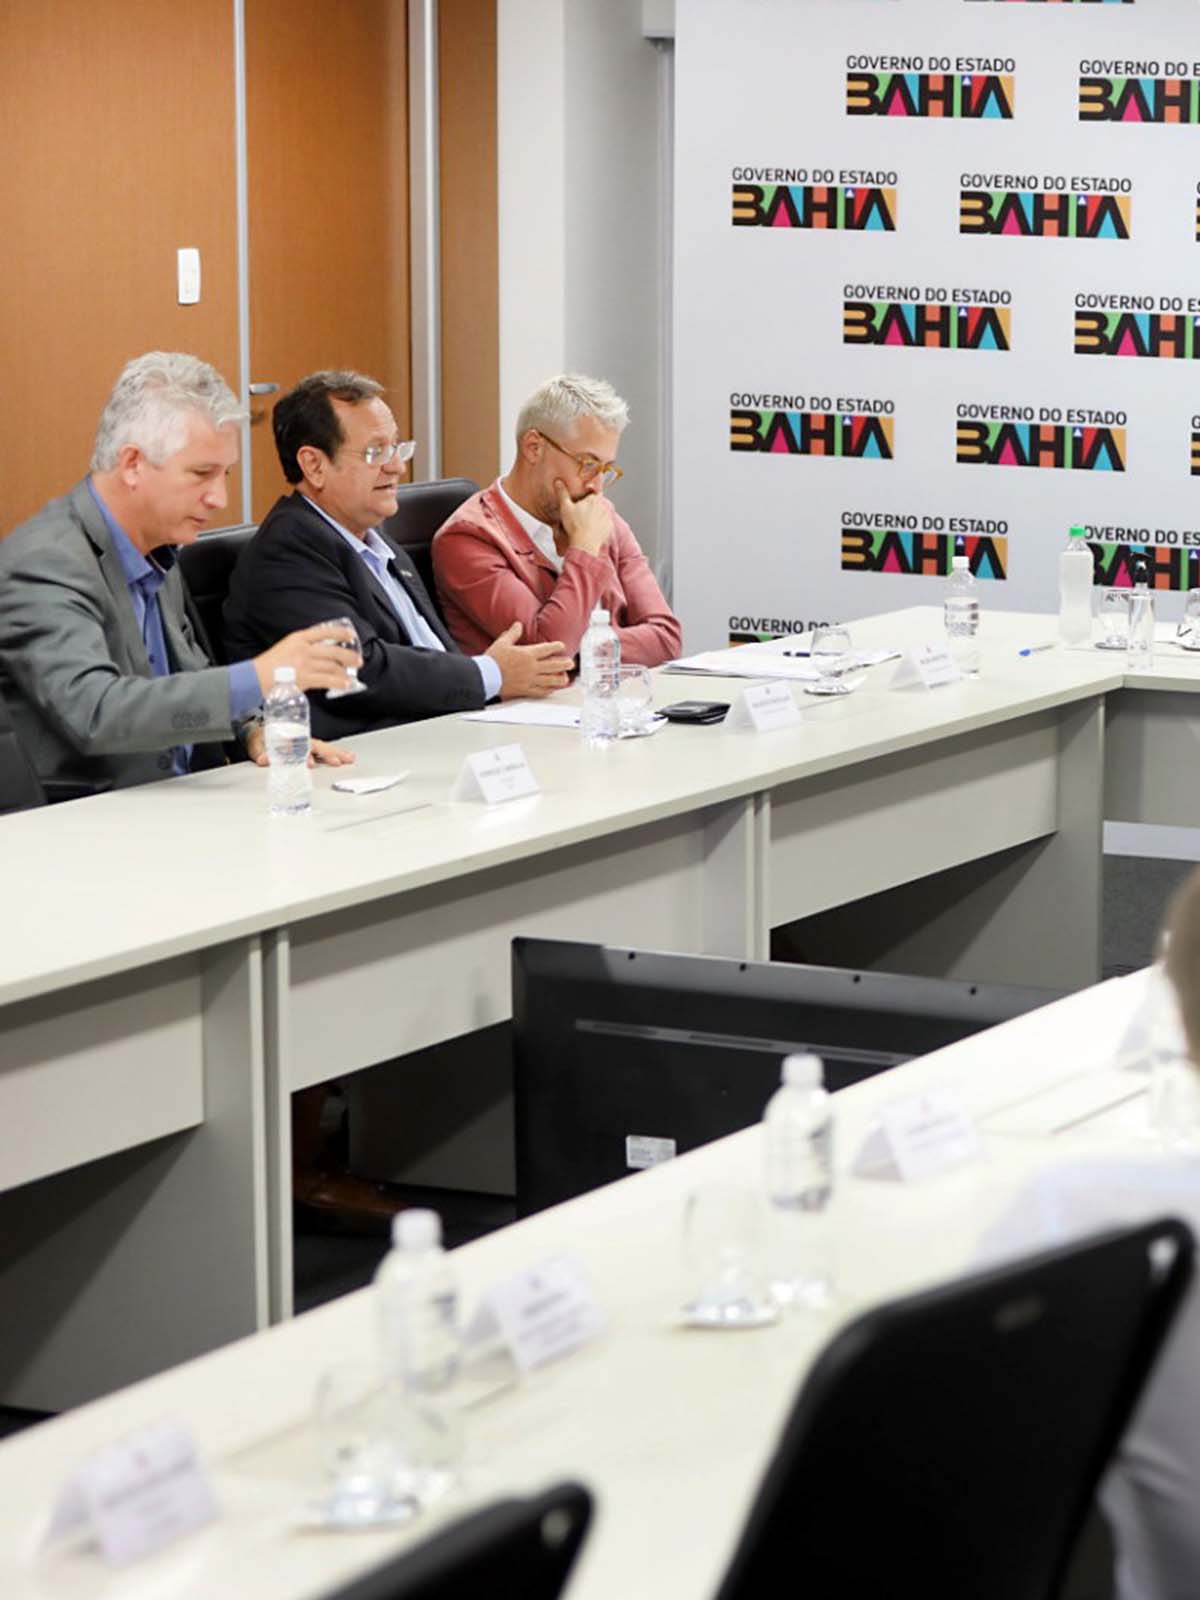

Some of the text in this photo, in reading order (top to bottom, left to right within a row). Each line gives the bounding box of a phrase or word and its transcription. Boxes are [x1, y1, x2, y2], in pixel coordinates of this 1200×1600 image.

[846, 55, 1016, 73] GOVERNO DO ESTADO
[1079, 59, 1160, 76] GOVERNO
[1164, 61, 1188, 77] DO
[847, 73, 1014, 119] BAHIA
[732, 167, 898, 186] GOVERNO DO ESTADO
[960, 174, 1132, 193] GOVERNO DO ESTADO
[733, 184, 896, 231] BAHIA
[960, 191, 1130, 239] BAHIA
[843, 284, 1012, 305] GOVERNO DO ESTADO
[1075, 293, 1155, 311] GOVERNO
[1159, 297, 1183, 312] DO
[844, 302, 1010, 350] BAHIA
[730, 392, 895, 414] GOVERNO DO ESTADO
[956, 403, 1127, 426] GOVERNO DO ESTADO
[731, 410, 894, 459] BAHIA
[957, 421, 1126, 471] BAHIA
[841, 511, 1009, 534] GOVERNO DO ESTADO
[1084, 525, 1151, 543] OVERNO
[1154, 529, 1179, 544] DO
[728, 615, 804, 637] GOVERNO
